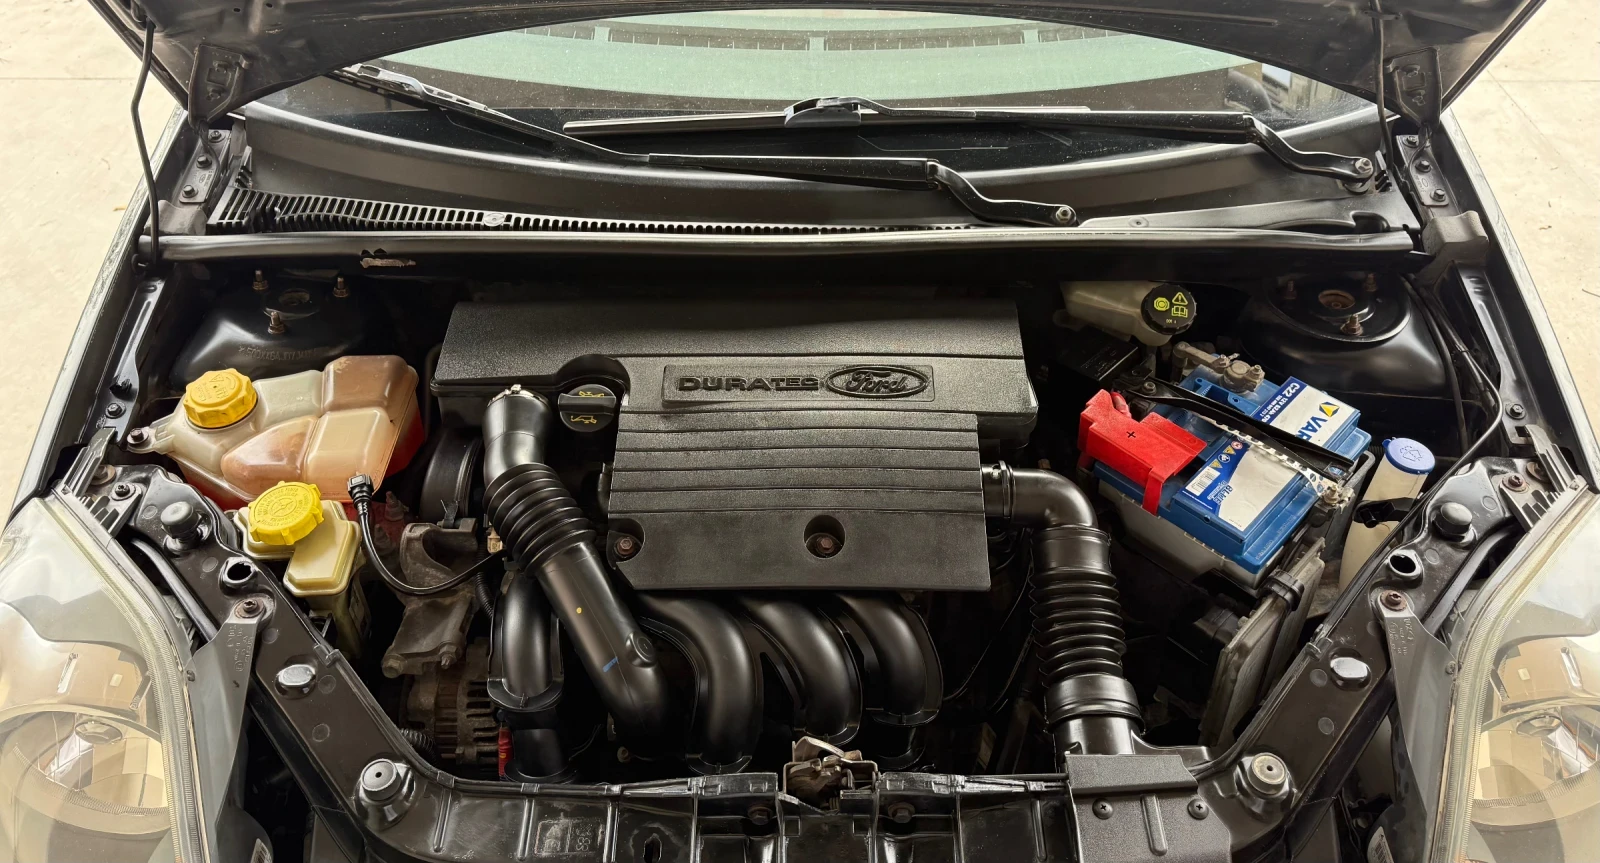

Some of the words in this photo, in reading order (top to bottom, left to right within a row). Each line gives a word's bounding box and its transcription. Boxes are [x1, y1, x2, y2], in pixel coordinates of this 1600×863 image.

[677, 376, 820, 392] DURATEC
[845, 369, 908, 394] Ford
[1281, 382, 1300, 397] C22
[1296, 416, 1328, 441] VAR
[1212, 484, 1234, 505] BLUE
